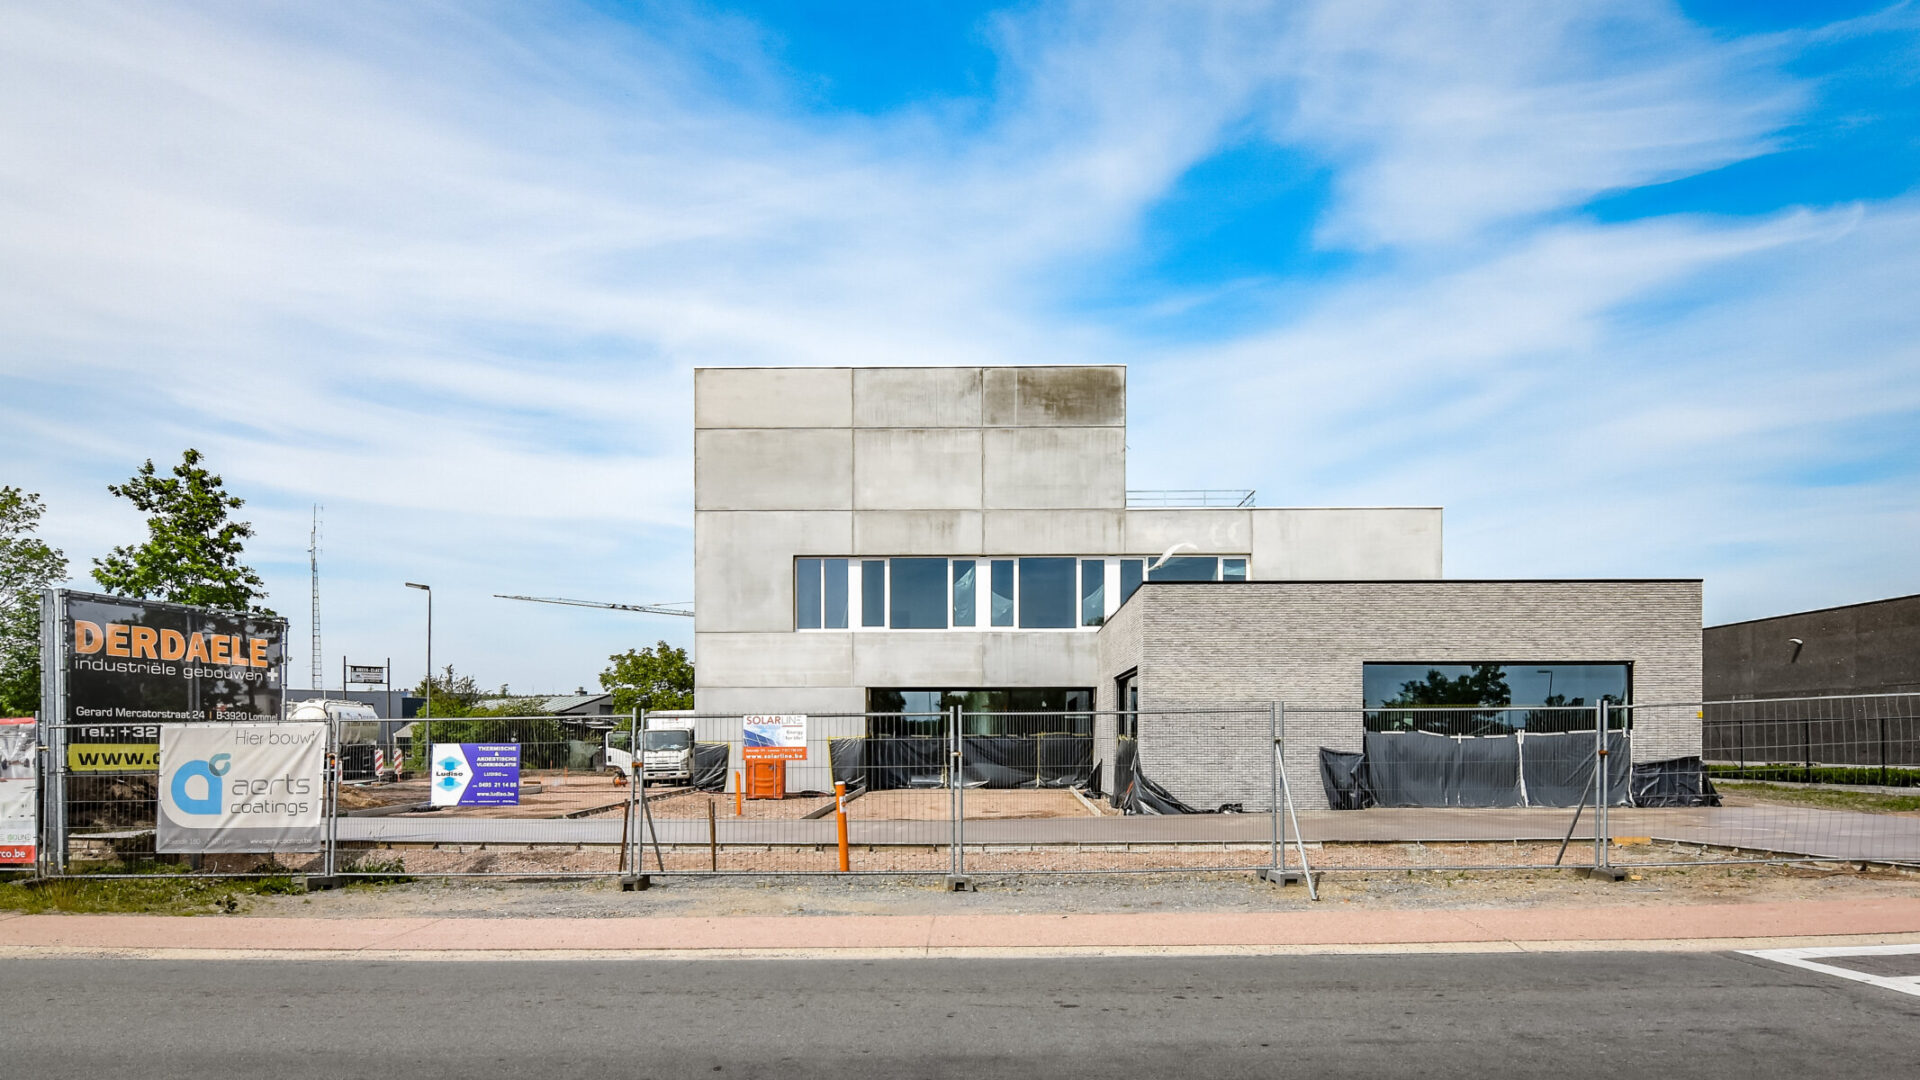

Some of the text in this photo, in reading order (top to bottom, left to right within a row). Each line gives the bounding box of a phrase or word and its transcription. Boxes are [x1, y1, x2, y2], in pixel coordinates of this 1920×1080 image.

[74, 620, 269, 669] DERDAELE
[74, 657, 176, 676] industriële
[183, 666, 264, 682] gebouwen
[75, 706, 279, 721] Gerard Mercatorstraat 24 B-3920 Lommel
[746, 716, 803, 725] SOLARLINE
[235, 728, 316, 745] Hier bouwt
[232, 773, 311, 796] aerts
[231, 799, 309, 817] coatings
